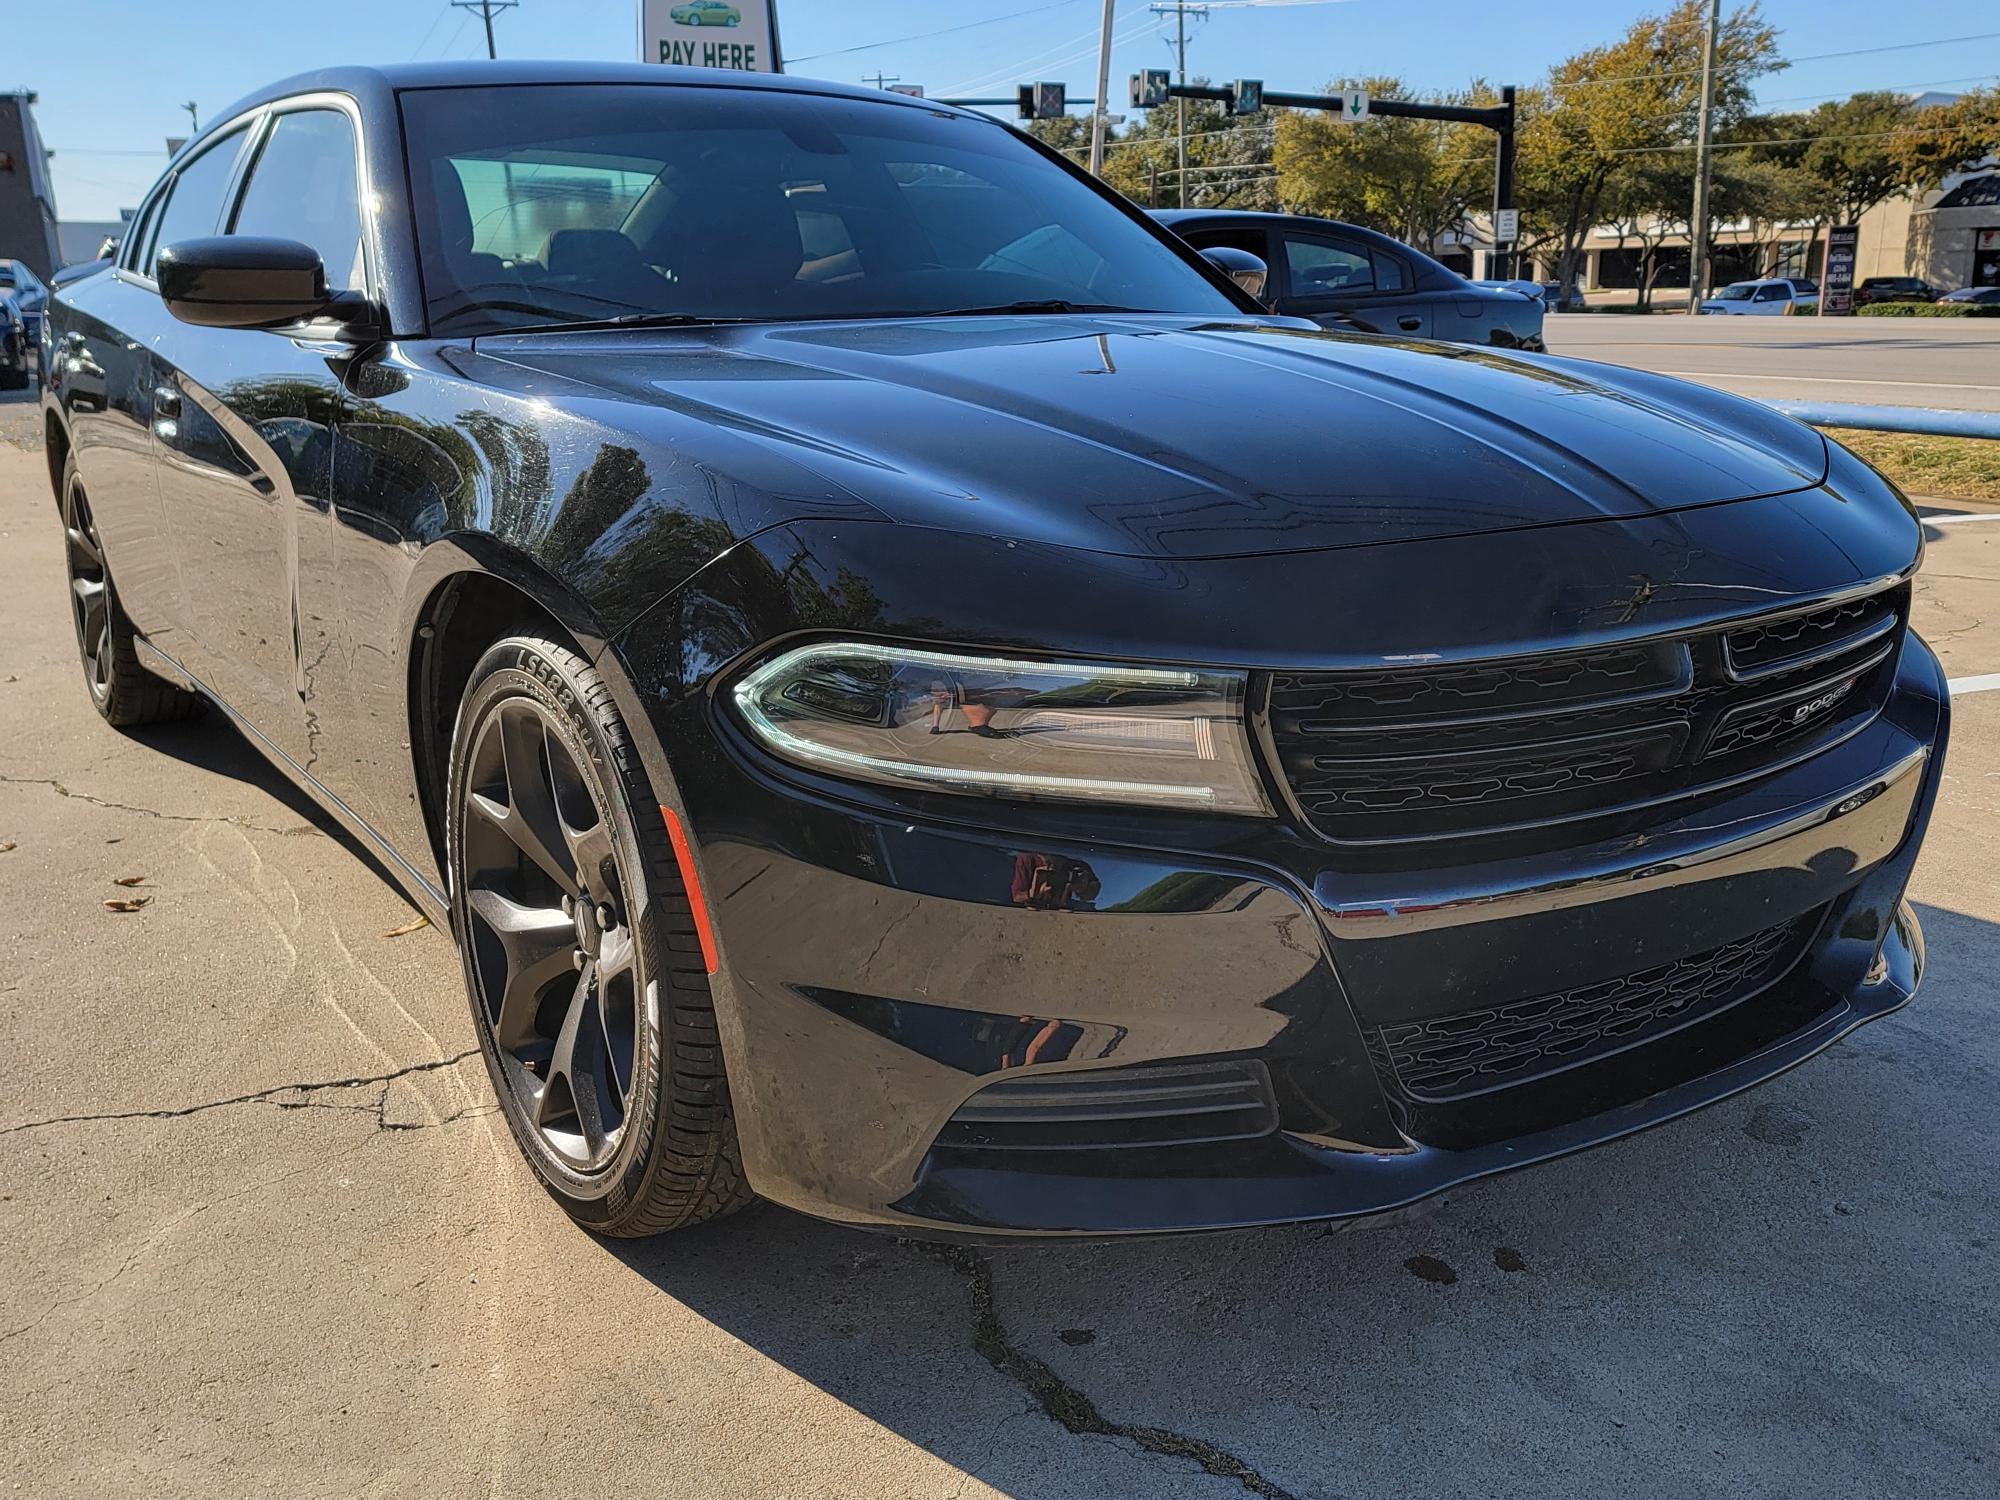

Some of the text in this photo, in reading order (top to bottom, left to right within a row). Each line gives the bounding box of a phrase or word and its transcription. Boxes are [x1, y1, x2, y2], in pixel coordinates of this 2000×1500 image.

[659, 40, 756, 71] PAY HERE
[515, 649, 575, 711] LS588
[572, 714, 604, 766] SUV
